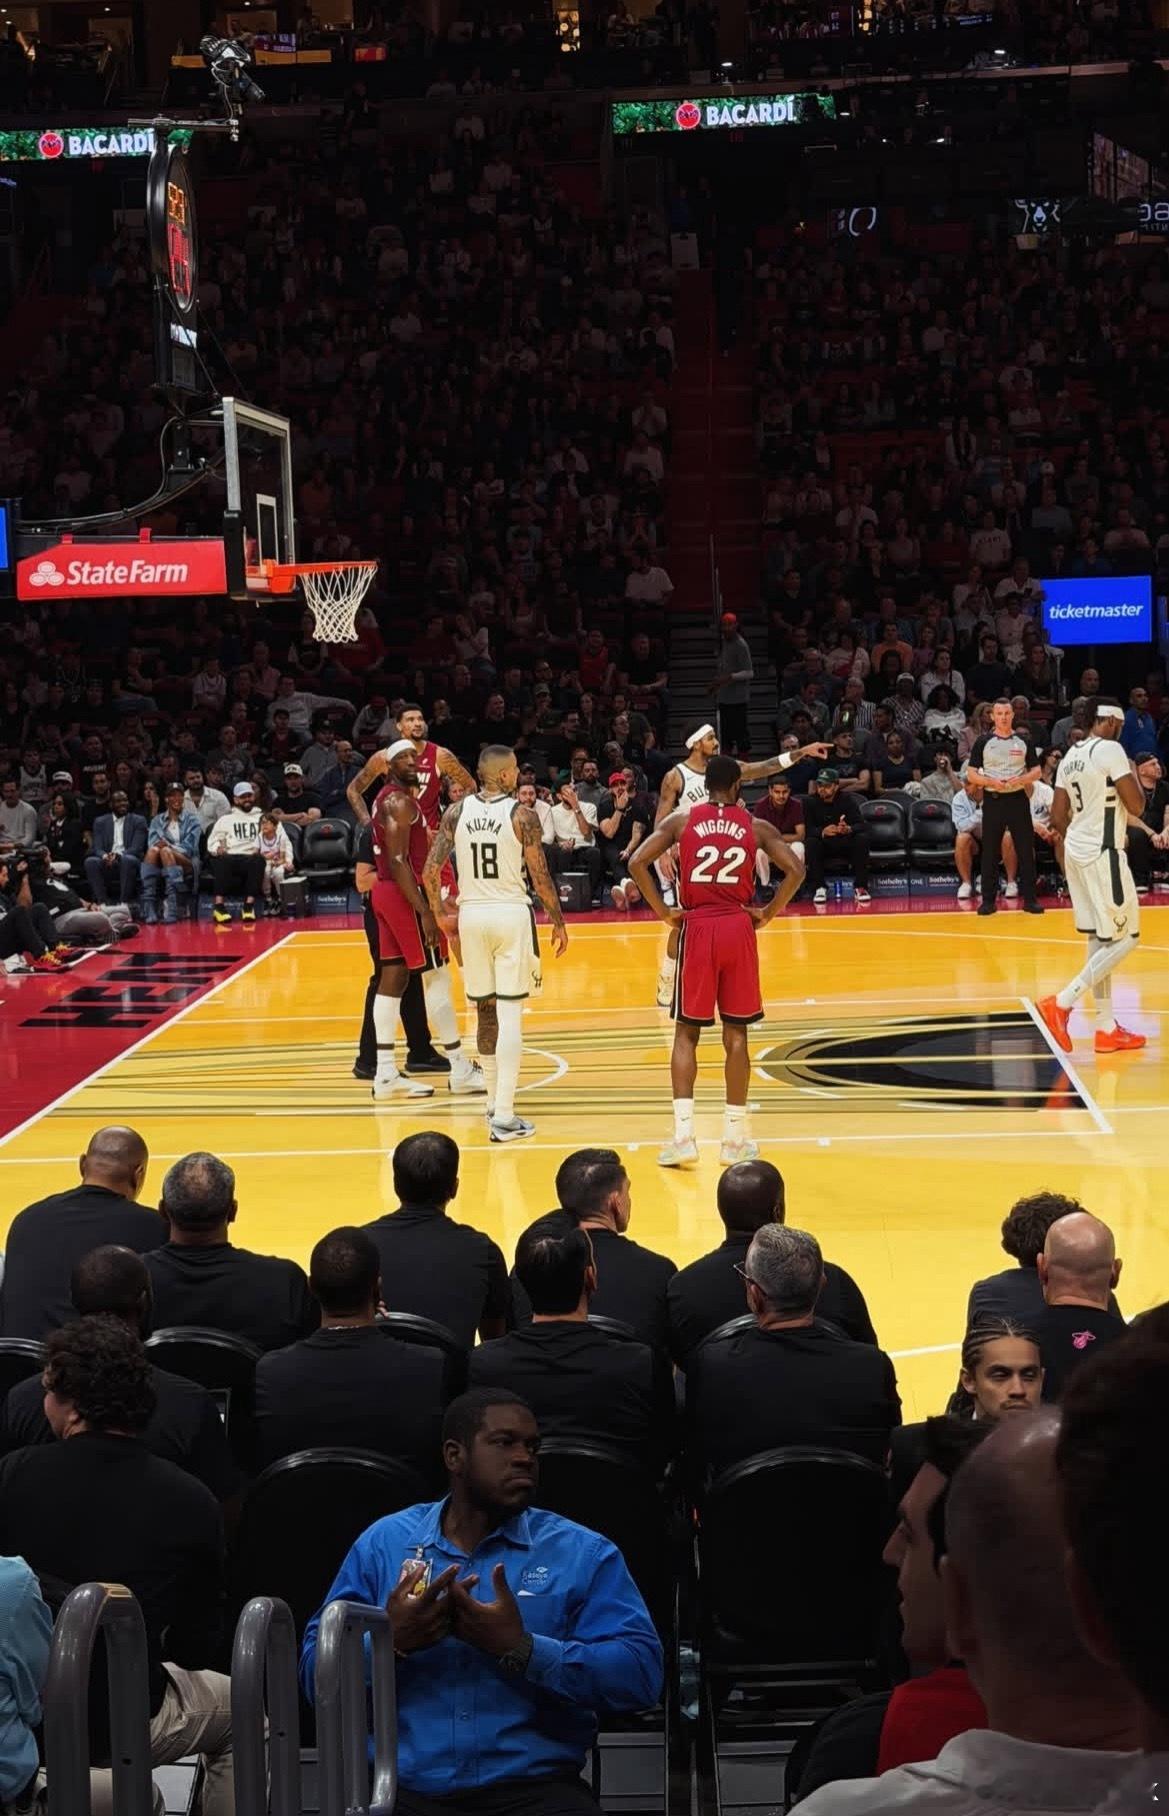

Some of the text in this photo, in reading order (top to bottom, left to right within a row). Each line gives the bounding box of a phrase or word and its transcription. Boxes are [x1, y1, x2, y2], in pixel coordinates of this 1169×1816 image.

[1049, 603, 1144, 619] ticketmaster
[687, 786, 710, 803] BU
[1071, 781, 1084, 812] 3
[466, 818, 502, 836] KUZMA
[693, 819, 747, 841] WIGGINS
[470, 842, 499, 879] 18
[690, 845, 747, 884] 22
